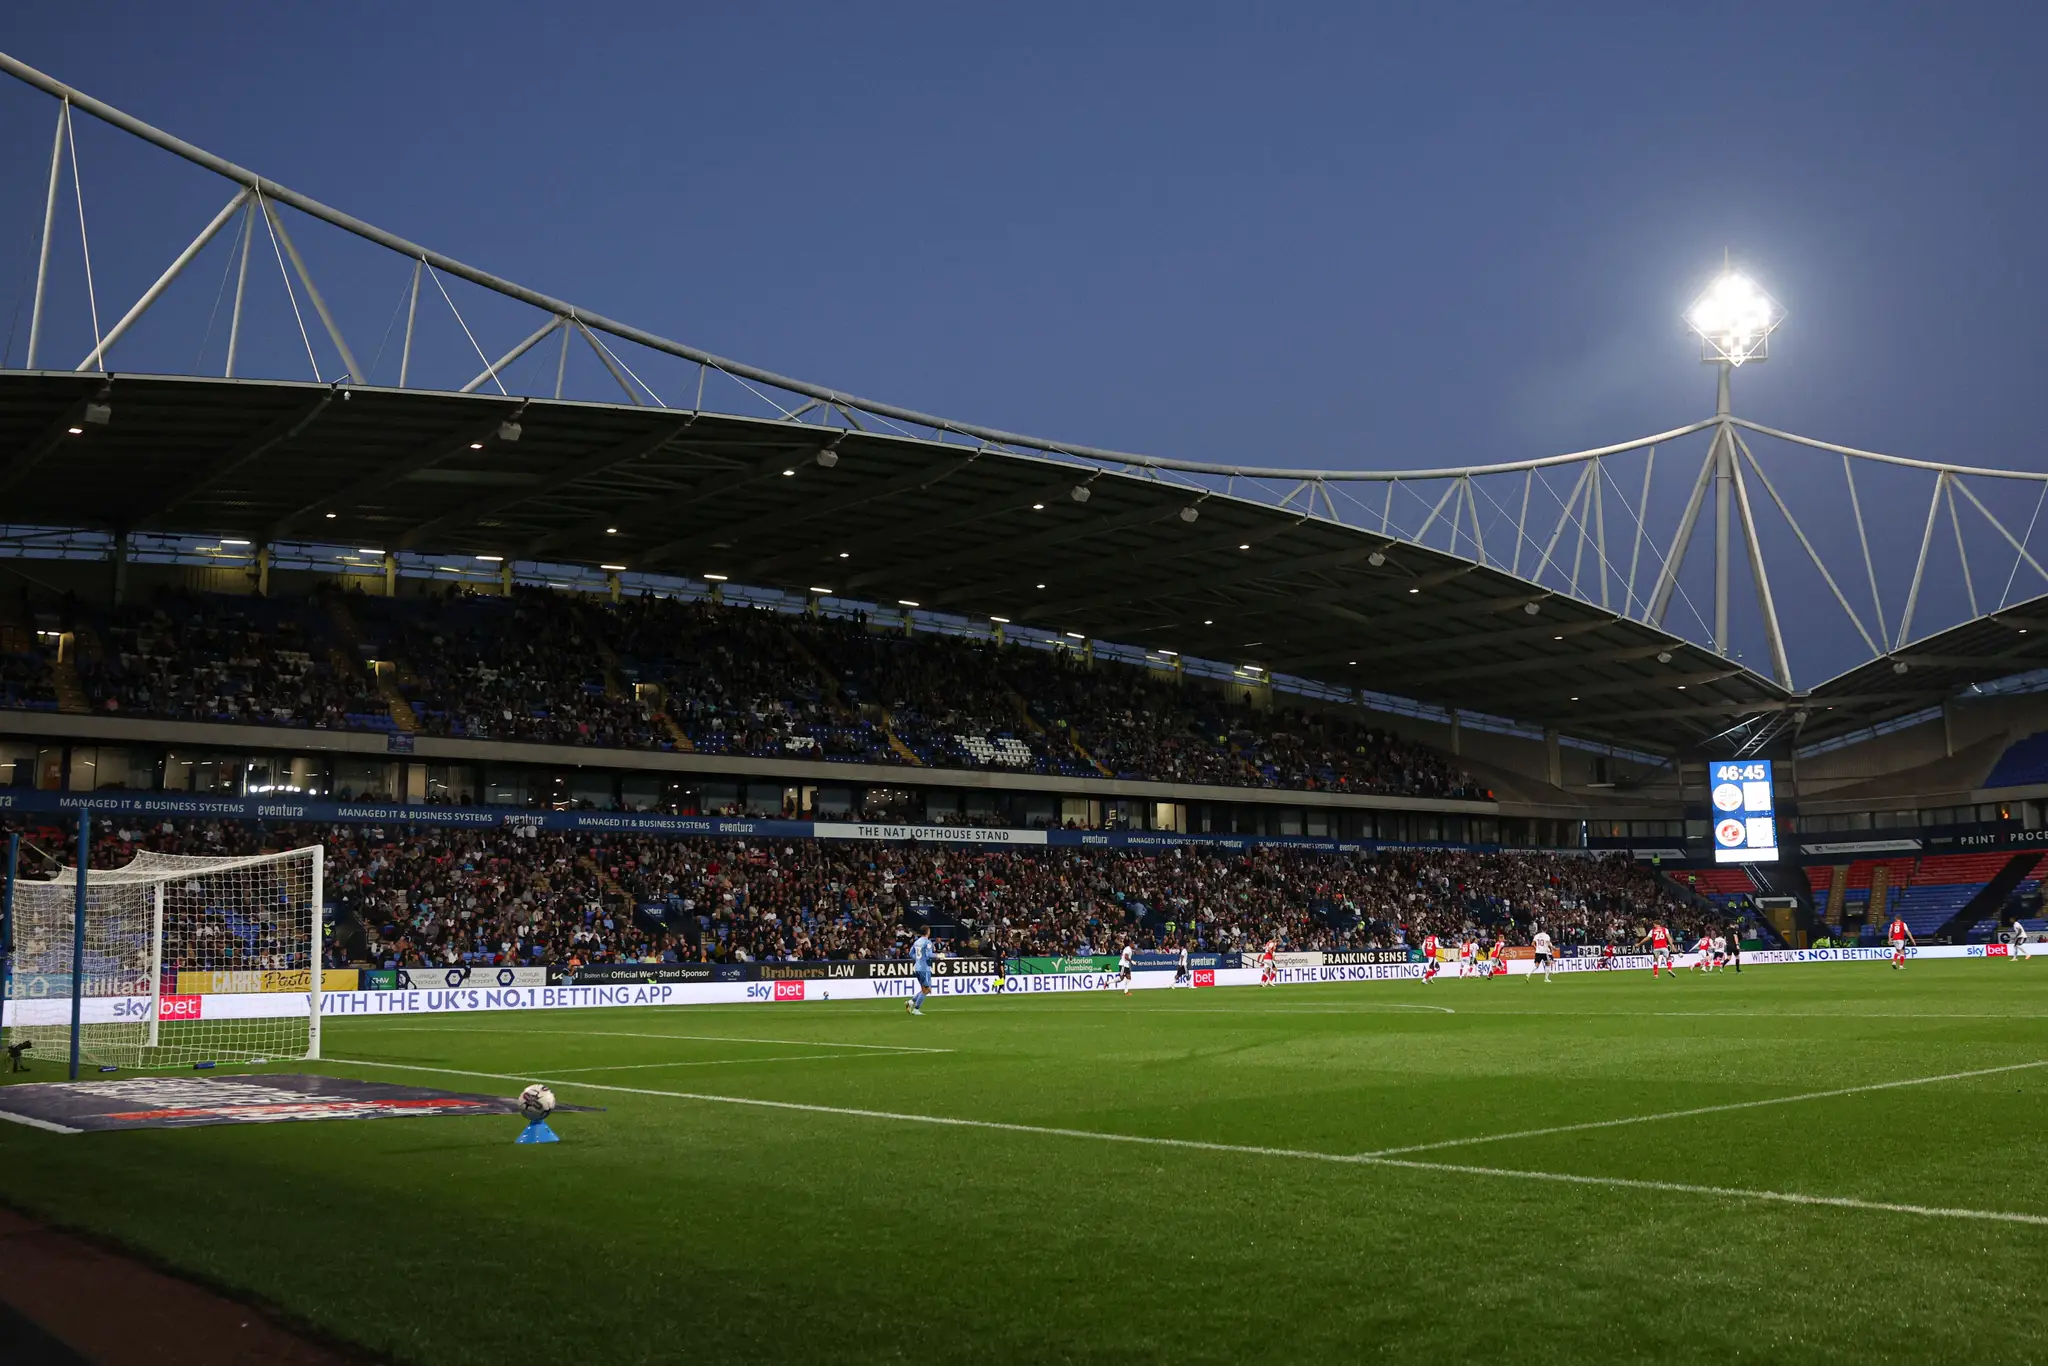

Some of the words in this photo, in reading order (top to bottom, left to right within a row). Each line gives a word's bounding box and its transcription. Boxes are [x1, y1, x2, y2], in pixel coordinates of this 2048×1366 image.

[1717, 764, 1765, 780] 46:45
[60, 798, 118, 808] MANAGED
[121, 800, 132, 809] IT
[134, 800, 142, 810] &
[145, 801, 196, 811] BUSINESS
[199, 803, 244, 813] SYSTEMS
[258, 804, 304, 817] eventura
[338, 808, 386, 818] MANAGED
[389, 810, 398, 818] IT
[400, 811, 406, 819] &
[409, 812, 452, 820] BUSINESS
[454, 813, 492, 822] SYSTEMS
[504, 814, 544, 826] eventura
[578, 818, 620, 827] MANAGED
[622, 819, 630, 827] IT
[638, 820, 675, 829] BUSINESS
[676, 821, 710, 830] SYSTEMS
[720, 822, 753, 832] eventura
[858, 826, 878, 836] THE
[884, 828, 906, 837] NAT
[910, 828, 971, 840] LOFTHOUSE
[976, 830, 1008, 840] STAND
[1082, 834, 1108, 844] eventura
[1960, 834, 1996, 845] PRINT
[1654, 932, 1665, 940] 26
[1894, 925, 1900, 934] 8
[1602, 946, 1640, 955] RKWEAR
[1752, 952, 1769, 962] WITH
[1770, 951, 1784, 961] THE
[1784, 950, 1804, 961] UK'S
[1810, 950, 1838, 960] NO.1
[1842, 948, 1892, 960] BETTING
[1904, 948, 1918, 958] PP
[1967, 946, 1984, 957] sky
[1988, 945, 2006, 955] bet
[1190, 957, 1216, 966] eventura
[1323, 953, 1375, 964] FRANKING
[1376, 952, 1407, 962] SENSE
[1566, 959, 1582, 970] THE
[1584, 958, 1604, 970] UK
[1626, 956, 1652, 968] BETTIN
[611, 970, 638, 978] Official
[681, 970, 710, 978] Sponsor
[760, 966, 824, 978] Brabners
[828, 964, 855, 977] LAW
[870, 962, 948, 976] FRANKG
[953, 961, 995, 974] SENSE
[1295, 968, 1317, 982] THE
[1320, 966, 1346, 980] UK'S
[1348, 965, 1373, 979] NO.1
[1376, 964, 1418, 978] BETTING
[1478, 962, 1490, 974] sky
[264, 971, 326, 989] Pastis
[1196, 972, 1213, 983] bet
[747, 983, 772, 1000] sky
[777, 983, 802, 996] bet
[873, 980, 915, 996] WITH
[930, 978, 950, 994] HE
[955, 978, 990, 994] UK'S
[1034, 974, 1093, 990] BETTING
[306, 992, 367, 1013] WITH
[375, 992, 420, 1011] THE
[428, 990, 479, 1010] UK'S
[486, 988, 534, 1008] NO.1
[544, 986, 630, 1006] BETTING
[634, 986, 672, 1004] APP
[113, 998, 152, 1020] sky
[160, 998, 197, 1014] bet
